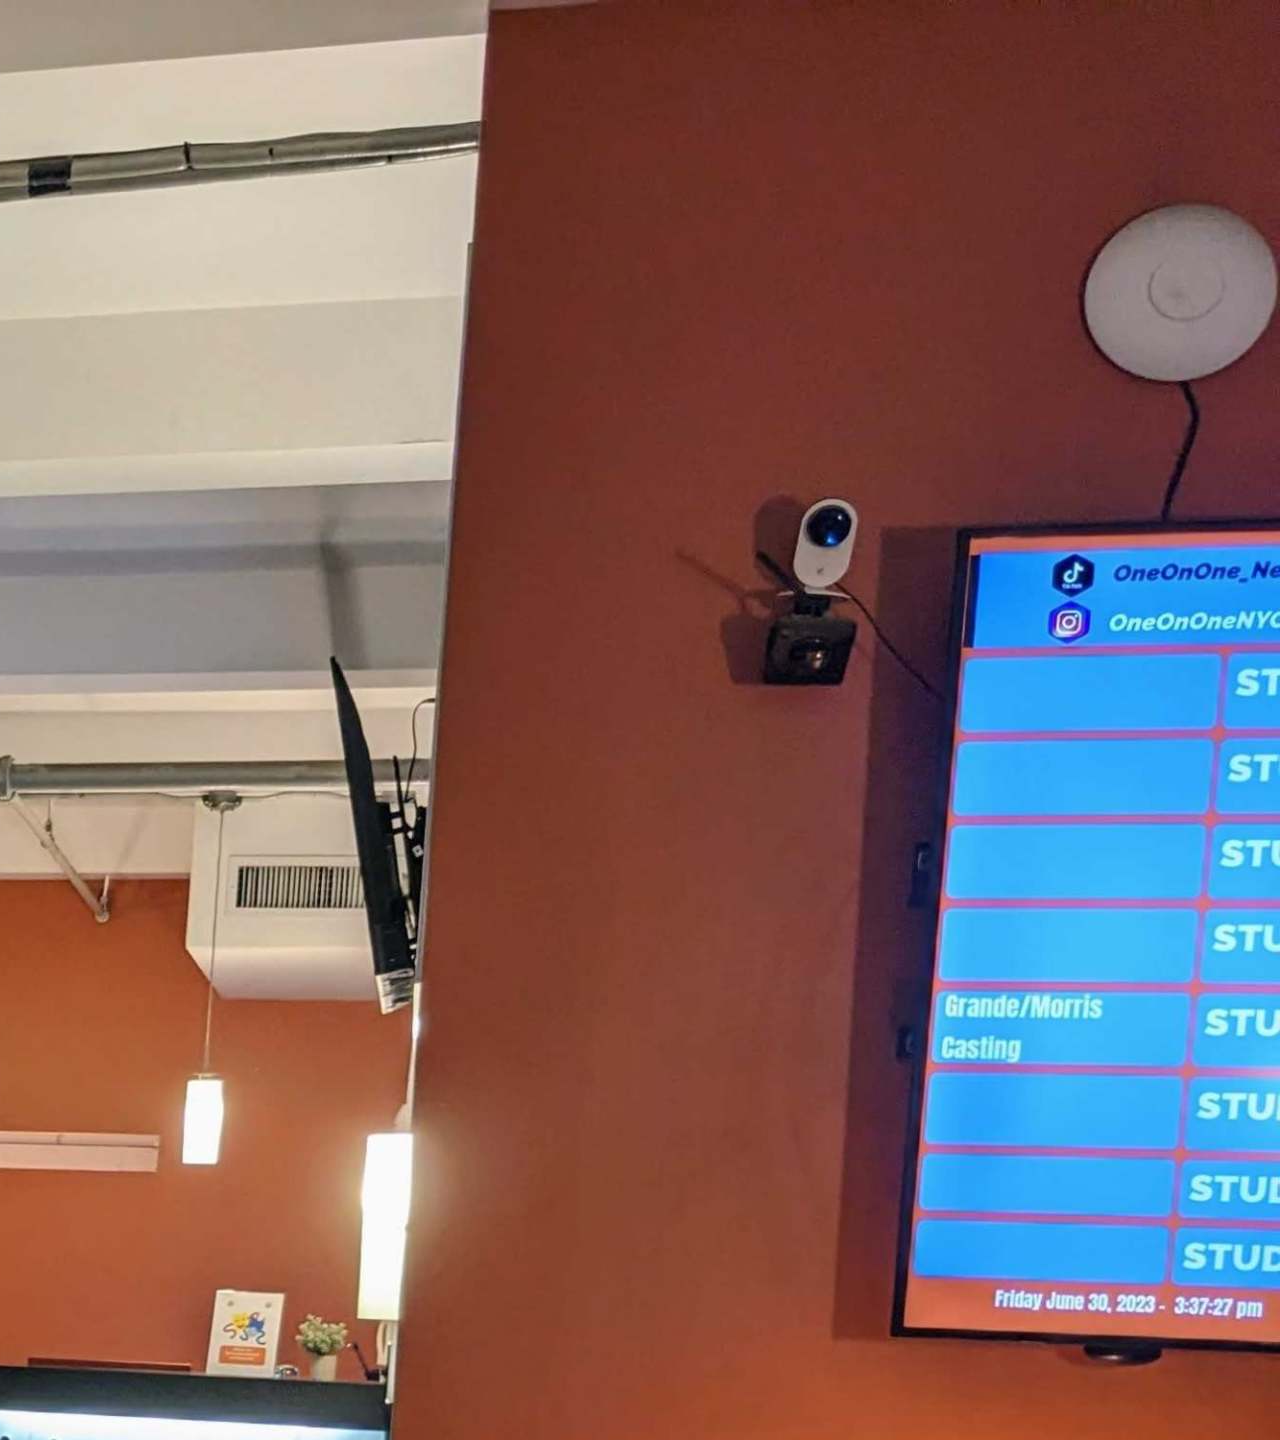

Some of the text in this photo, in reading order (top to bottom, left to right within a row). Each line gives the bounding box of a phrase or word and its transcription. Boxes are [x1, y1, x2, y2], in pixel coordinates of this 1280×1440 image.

[1228, 754, 1280, 783] ST
[945, 993, 1103, 1020] Grande/Morris
[1204, 1009, 1280, 1038] STU
[941, 1035, 1022, 1063] Casting
[1196, 1092, 1280, 1122] STU
[1182, 1242, 1280, 1272] STUD
[995, 1289, 1042, 1311] Friday
[1046, 1292, 1084, 1311] June
[1088, 1293, 1112, 1314] 30,
[1116, 1295, 1156, 1314] 2023
[1174, 1297, 1232, 1317] 3:37:27
[1236, 1301, 1264, 1319] pm
